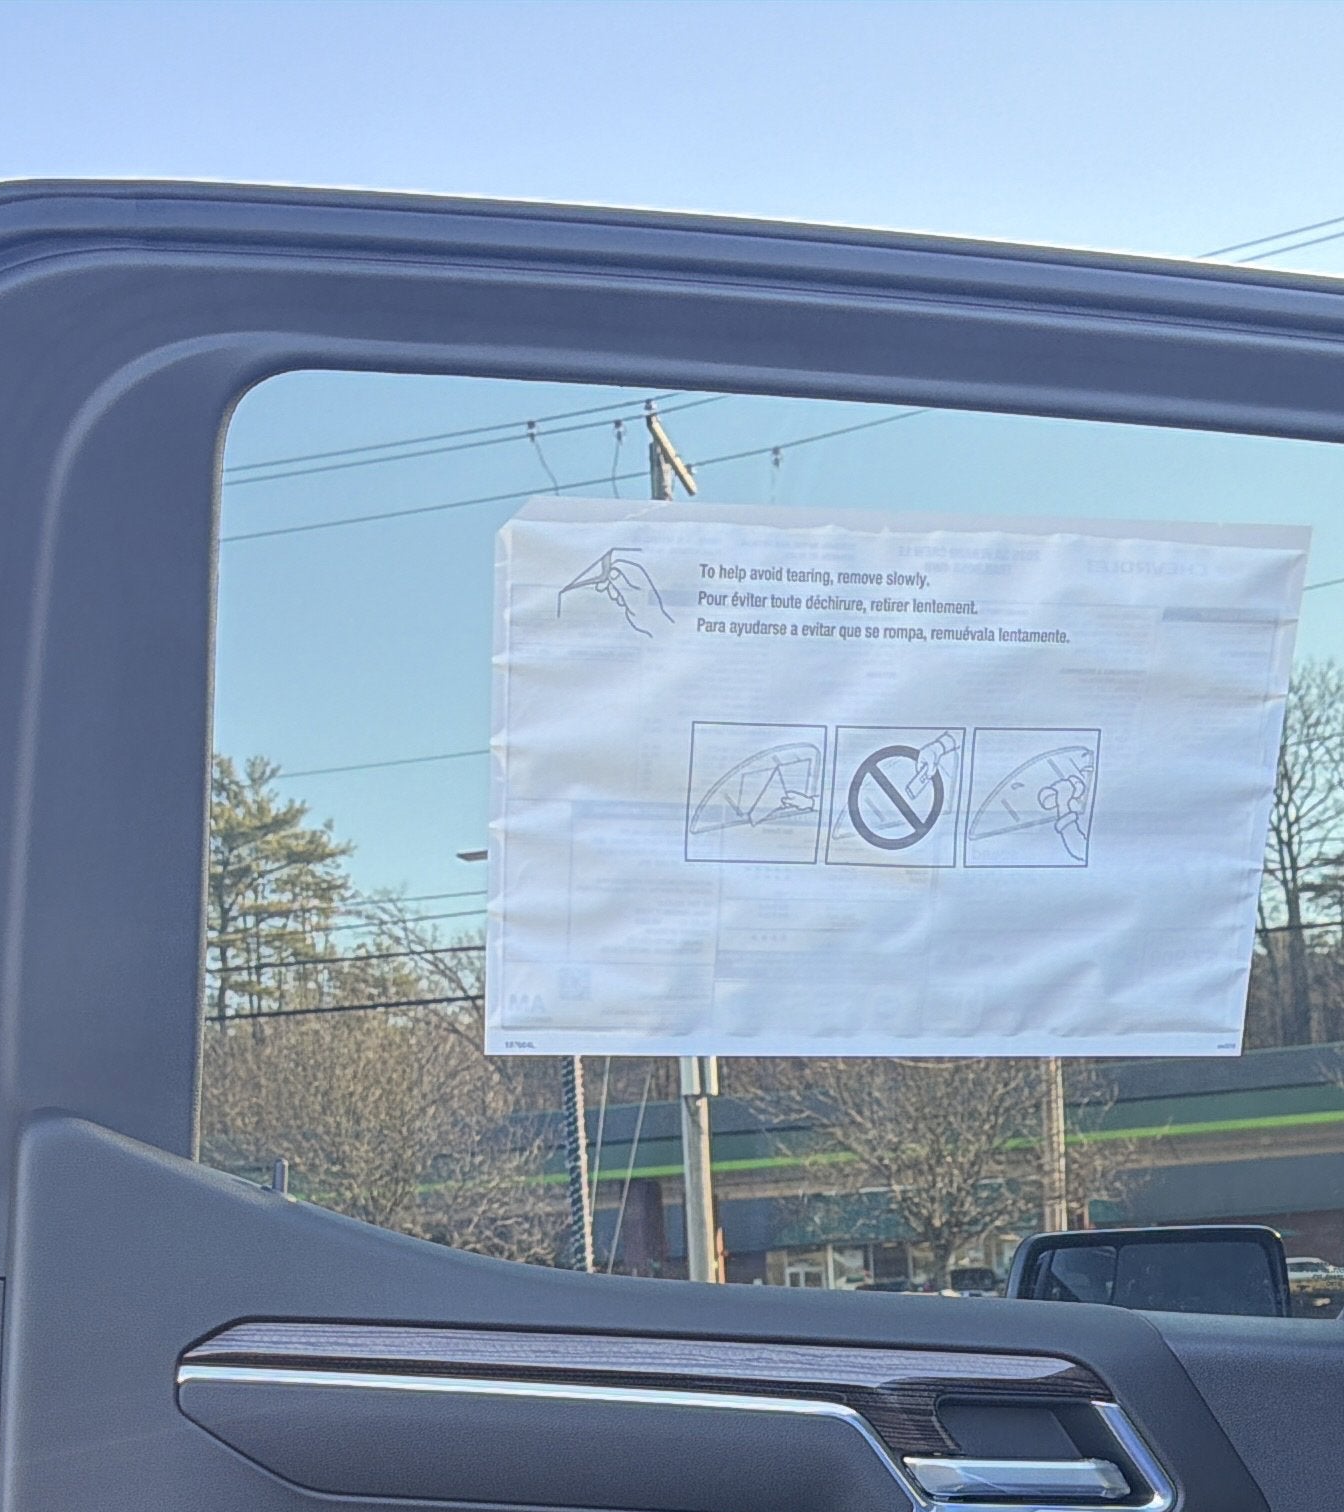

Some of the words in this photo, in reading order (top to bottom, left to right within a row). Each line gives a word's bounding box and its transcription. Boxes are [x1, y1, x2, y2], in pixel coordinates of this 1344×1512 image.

[699, 563, 715, 579] To
[718, 564, 747, 583] help
[750, 566, 783, 583] avoid
[786, 567, 834, 587] tearing,
[837, 571, 883, 585] remove
[886, 571, 931, 590] slowly.
[698, 591, 728, 606] Pour
[731, 590, 767, 608] éviter
[770, 594, 802, 609] toute
[805, 595, 867, 614] déchirure,
[870, 597, 910, 613] retirer
[913, 598, 979, 615] lentement.
[696, 617, 726, 633] Para
[729, 620, 787, 637] ayudarse
[790, 623, 798, 636] a
[802, 621, 837, 637] evitar
[838, 625, 861, 641] que
[864, 626, 880, 638] se
[883, 627, 928, 642] rompa,
[930, 625, 995, 642] remuévala
[998, 627, 1071, 644] lentamente.
